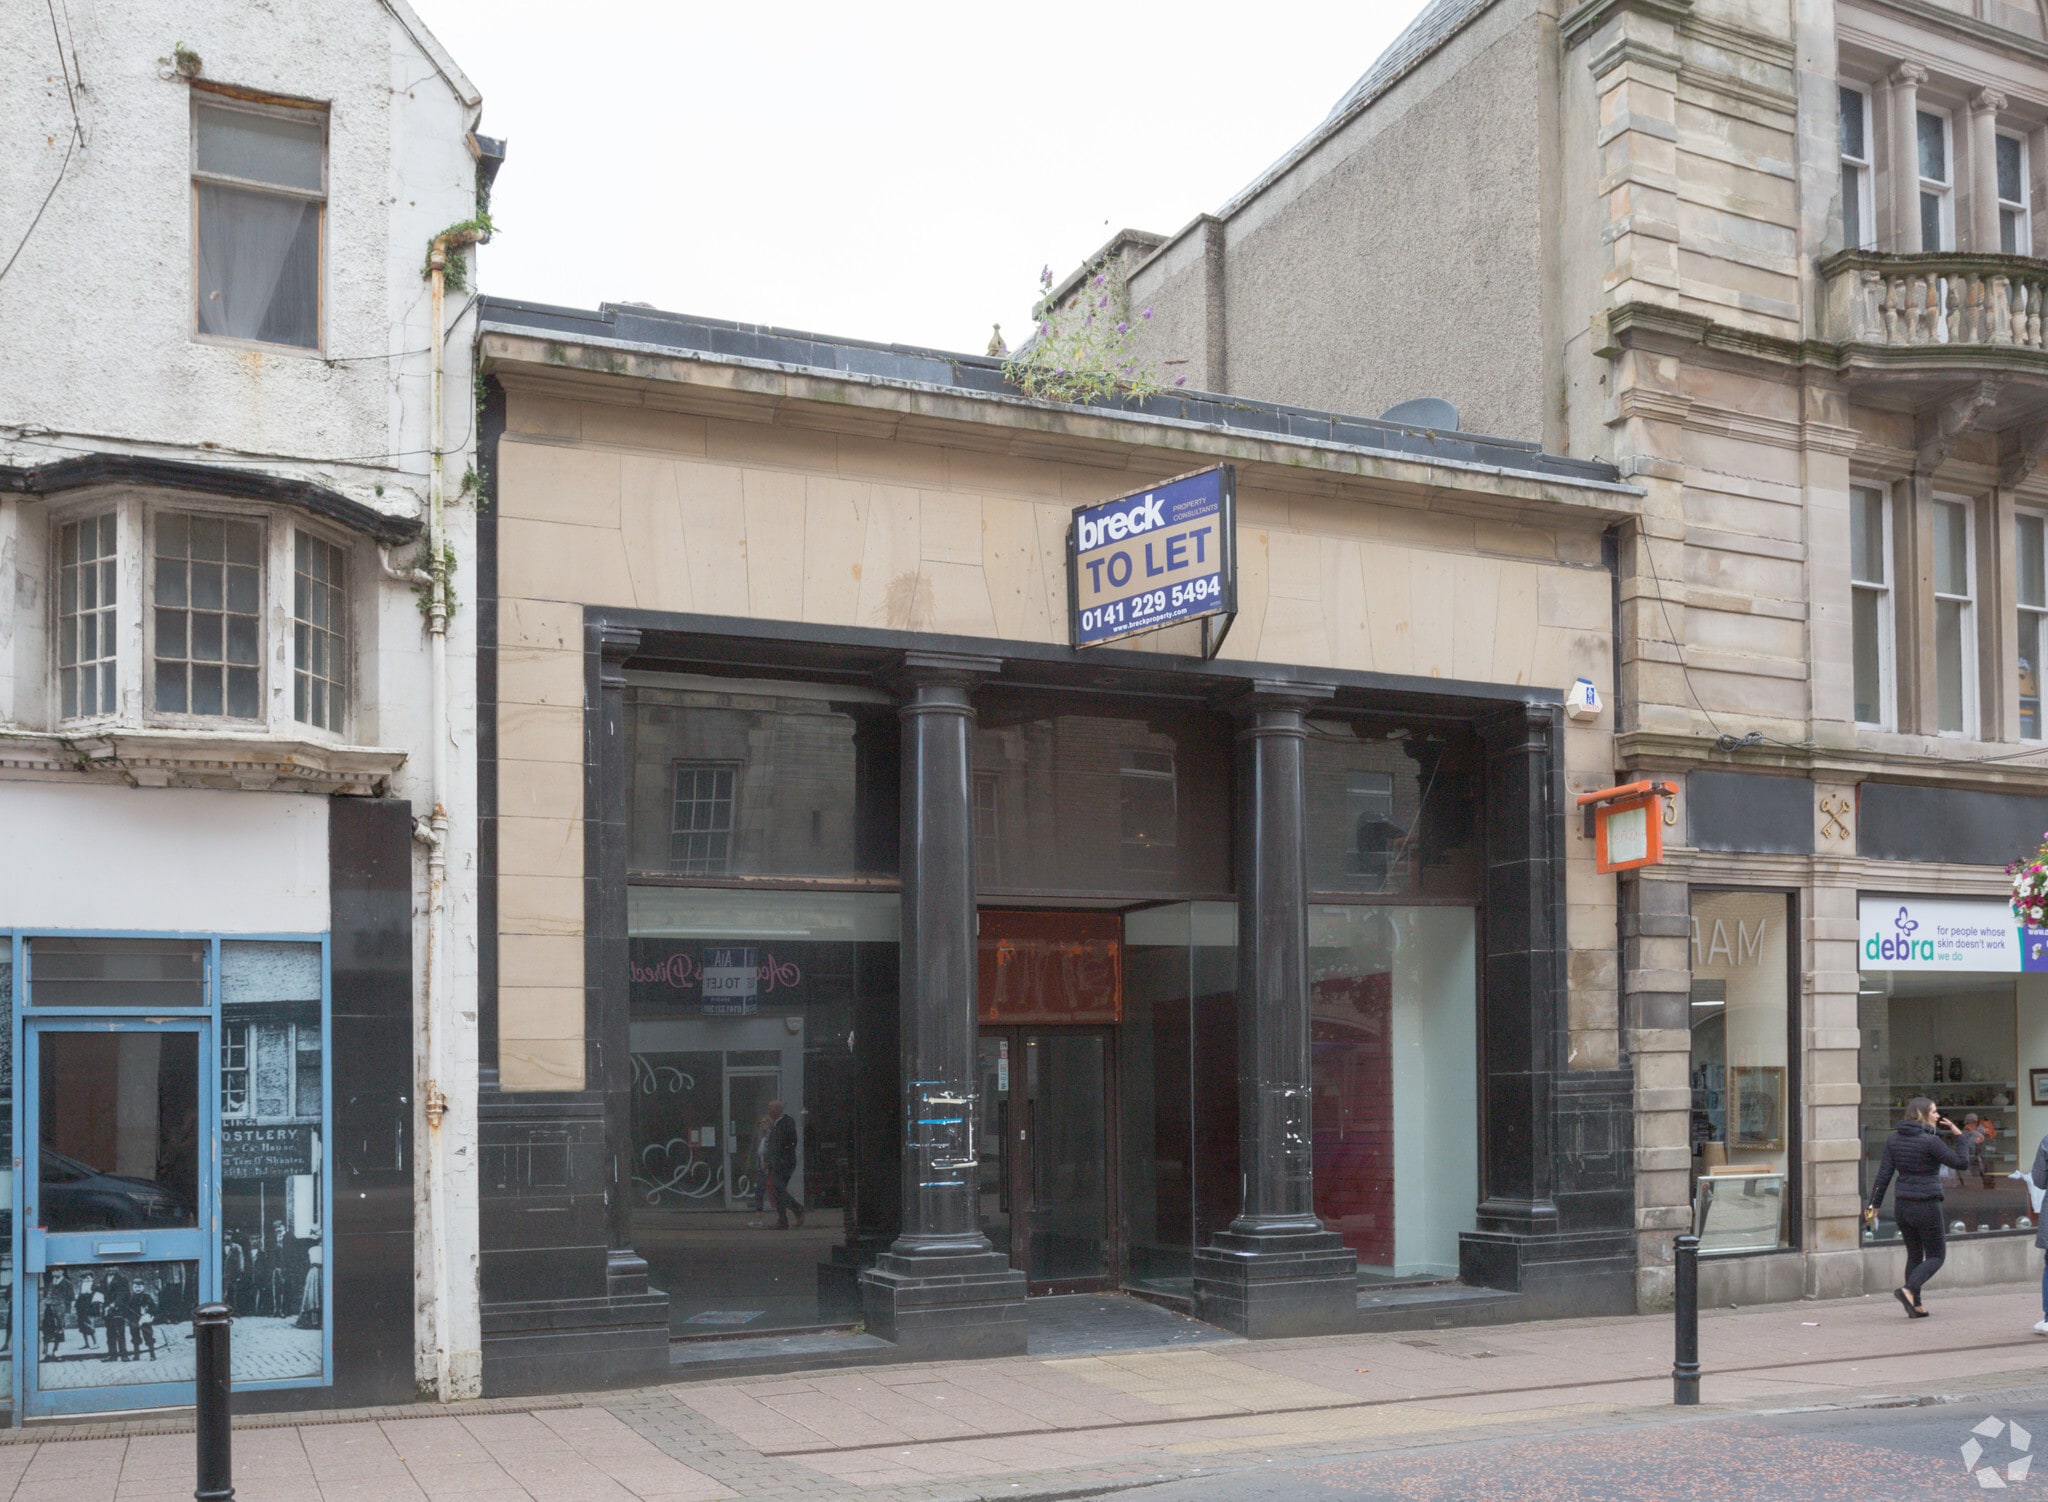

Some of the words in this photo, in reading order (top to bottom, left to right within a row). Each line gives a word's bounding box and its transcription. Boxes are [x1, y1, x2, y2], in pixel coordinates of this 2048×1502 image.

[1173, 496, 1207, 512] PROPERTY
[1173, 503, 1218, 521] CONSULTANTS
[1078, 494, 1165, 552] breck
[1086, 551, 1132, 594] TO
[1145, 526, 1212, 578] LET
[1082, 602, 1125, 631] 0141
[1132, 591, 1166, 619] 229
[1172, 575, 1221, 607] 5494
[1112, 608, 1188, 633] www.breckproperty.com
[1937, 925, 1949, 935] for
[1951, 926, 1978, 937] people
[1980, 926, 2006, 937] whose
[1865, 932, 1934, 961] debra
[1937, 938, 1954, 948] skin
[1986, 940, 2006, 949] work
[1937, 953, 1950, 961] we
[1952, 951, 1963, 961] do
